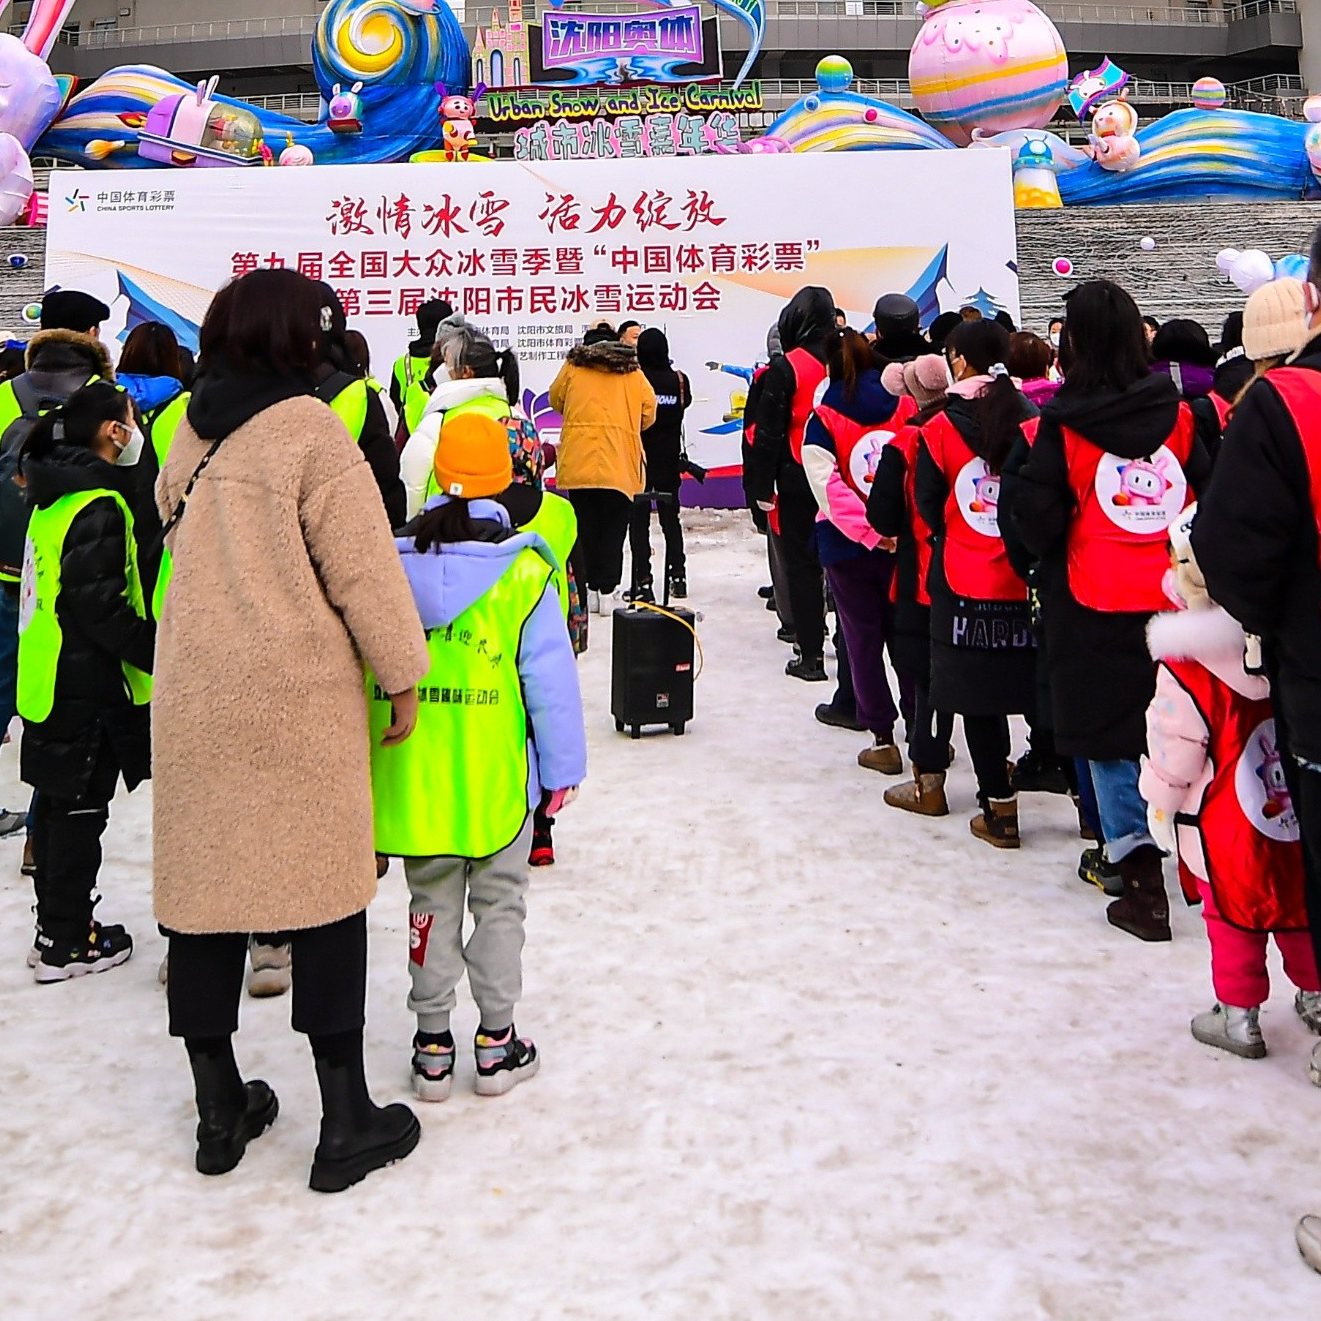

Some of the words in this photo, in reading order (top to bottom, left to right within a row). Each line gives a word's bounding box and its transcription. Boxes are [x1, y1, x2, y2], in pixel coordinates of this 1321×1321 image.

[550, 15, 696, 58] 沈阳奥体
[489, 94, 544, 120] Urban
[549, 91, 599, 118] Snow
[606, 92, 641, 114] and
[646, 86, 680, 112] Ice
[685, 80, 762, 111] Carnival
[516, 112, 741, 160] 城市冰雪嘉年华
[97, 190, 176, 203] 中国体育彩票
[326, 190, 511, 240] 激情冰雪
[538, 189, 728, 234] 活力绽放
